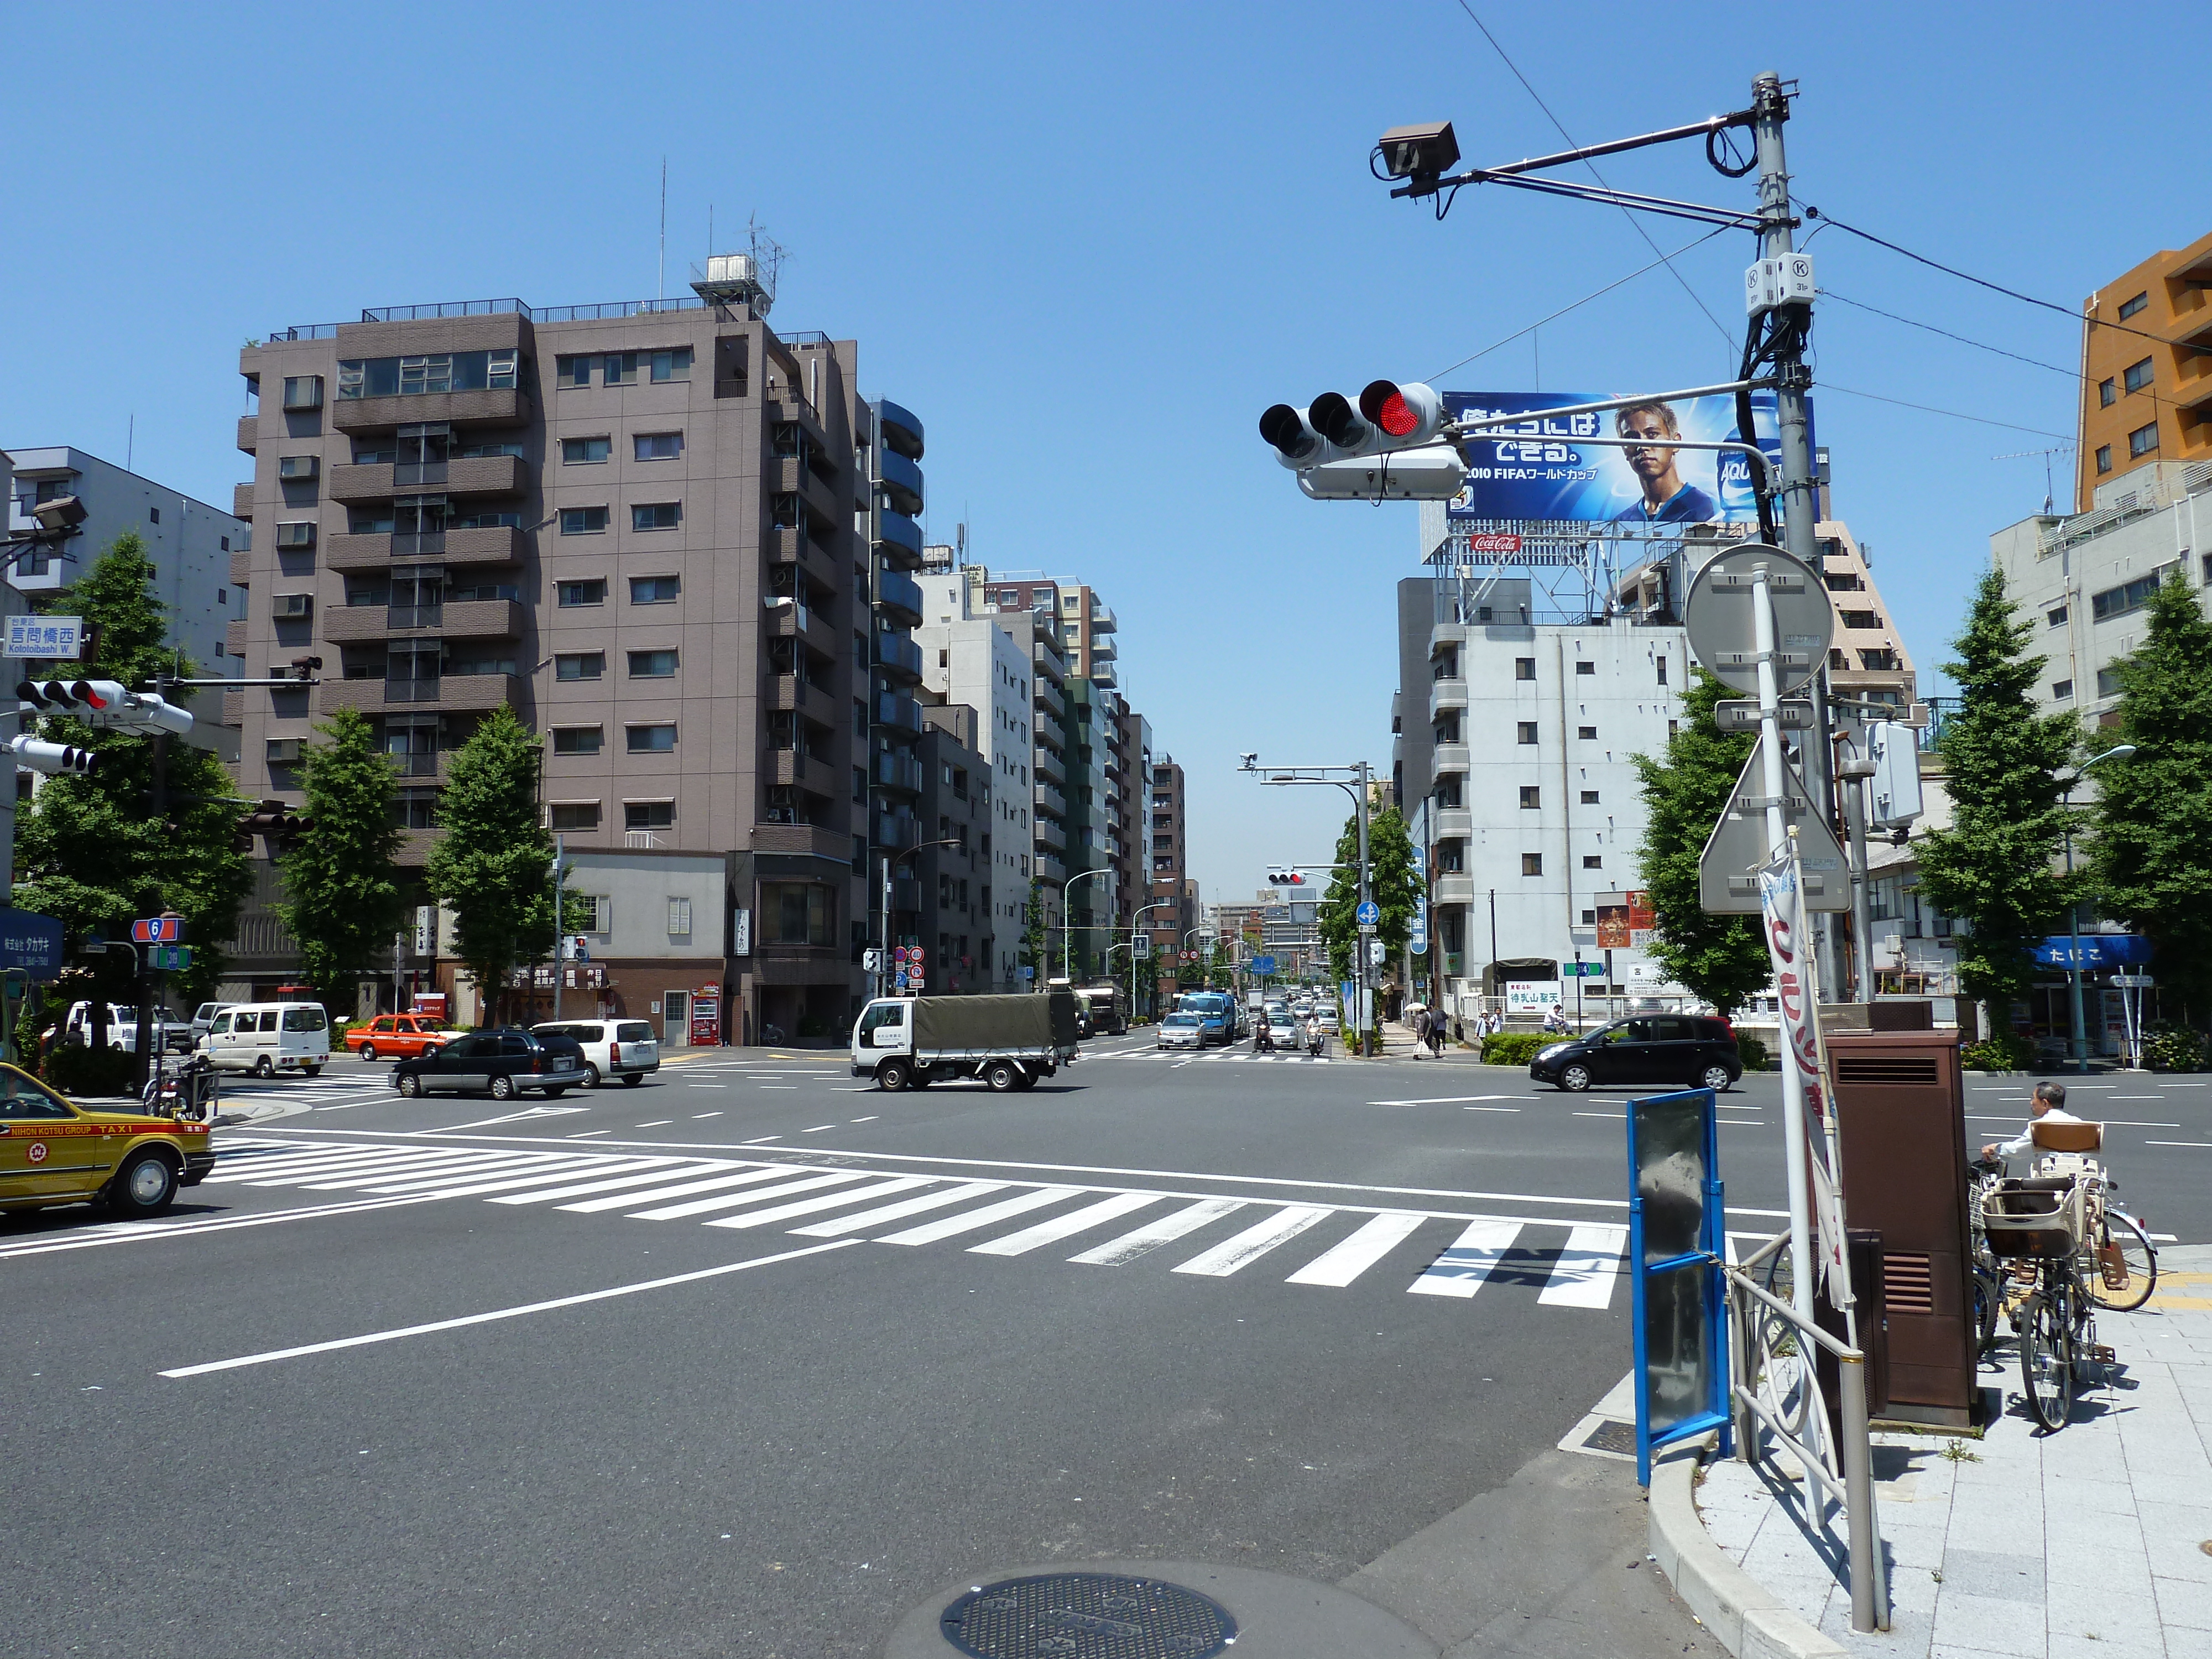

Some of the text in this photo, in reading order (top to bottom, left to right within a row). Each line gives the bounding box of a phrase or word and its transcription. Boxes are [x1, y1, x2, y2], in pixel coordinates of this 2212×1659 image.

[1492, 440, 1577, 462] できる。
[1467, 468, 1598, 481] 2010 FIFAワールドカップ
[1475, 537, 1517, 550] Coca-Cola
[12, 618, 35, 626] 台東区
[11, 628, 74, 644] 言問橋西
[9, 644, 71, 654] Kototoibashi W.
[152, 921, 159, 936] 6
[26, 936, 49, 952] タカサキ
[168, 952, 178, 964] 319
[1510, 993, 1558, 1003] 待乳山聖天
[12, 1125, 132, 1136] NIHON KOTSU GROUP TAXI
